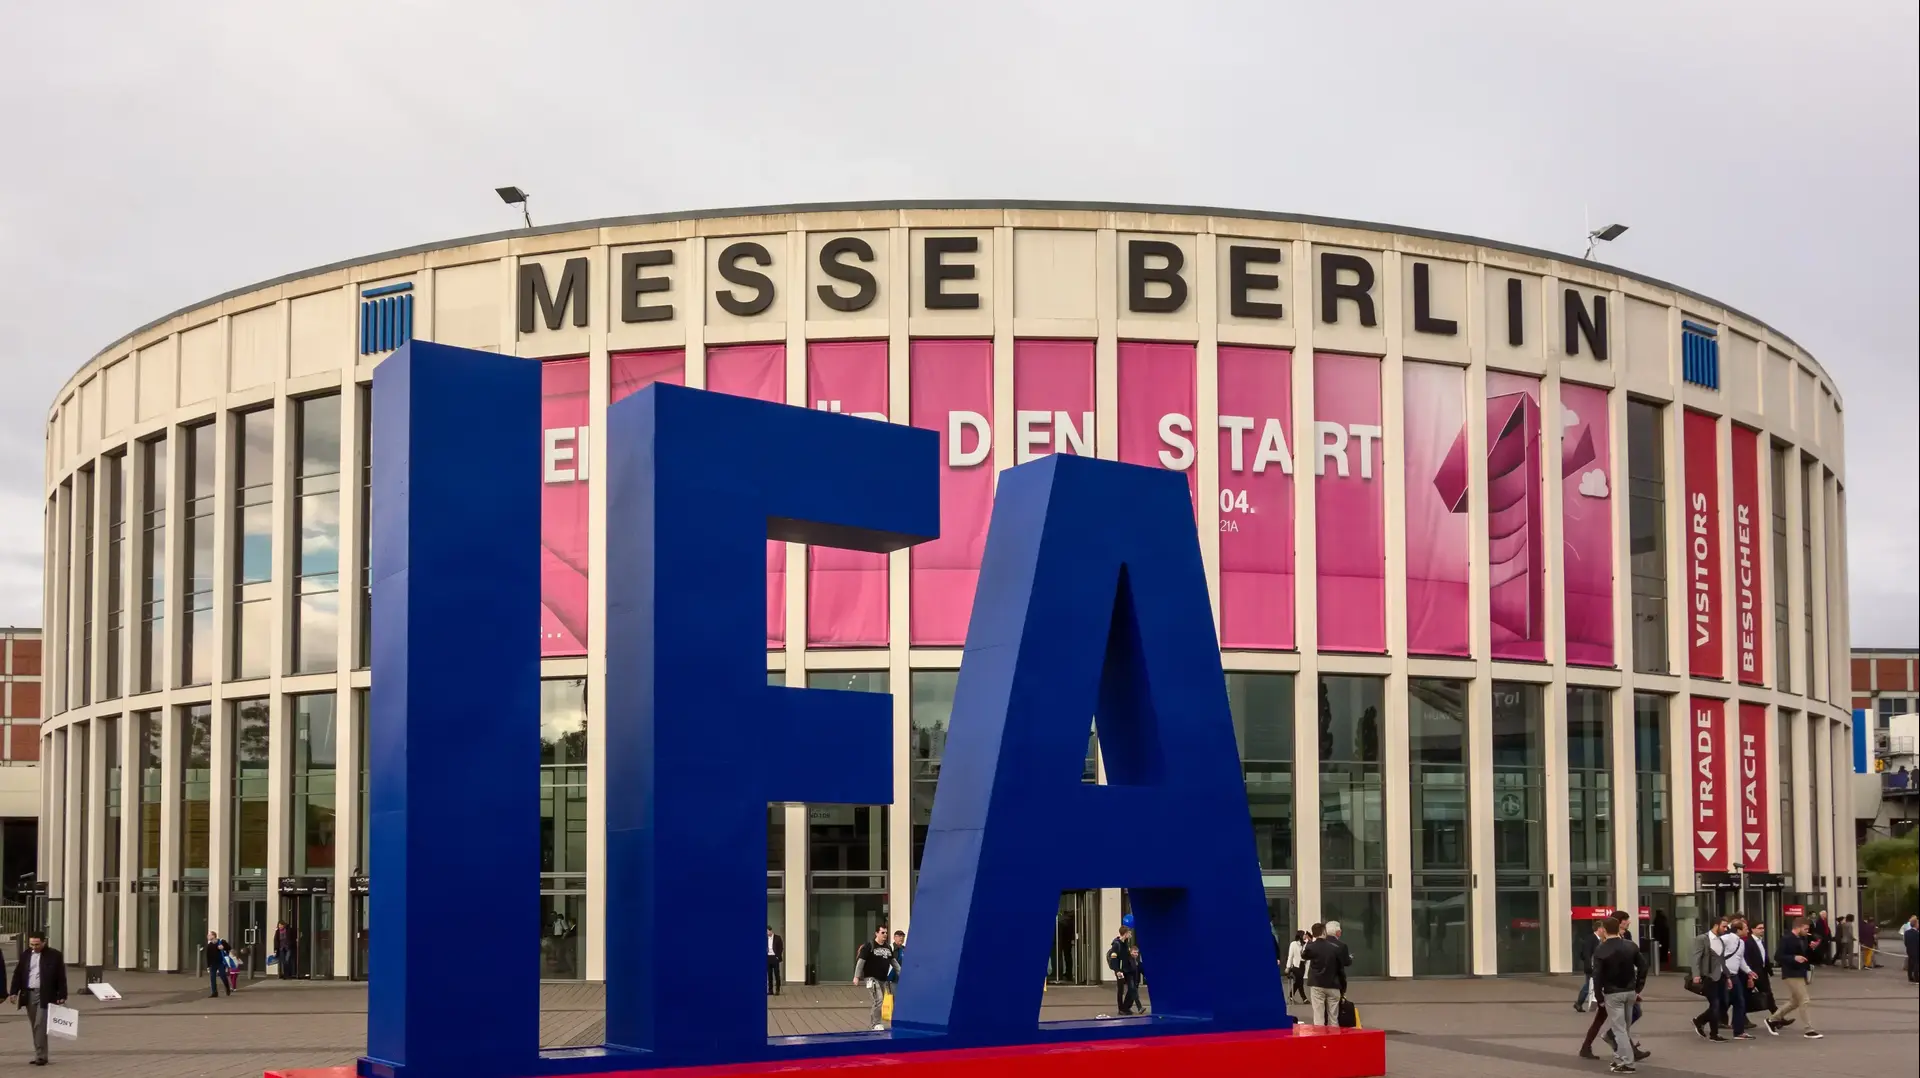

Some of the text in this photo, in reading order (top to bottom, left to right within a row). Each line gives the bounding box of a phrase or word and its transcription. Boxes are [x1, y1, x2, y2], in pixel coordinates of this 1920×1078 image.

[519, 237, 1608, 360] MESSE BERLIN
[949, 410, 1095, 467] DEN
[1158, 413, 1383, 479] START
[1219, 519, 1239, 533] 21A
[1691, 492, 1709, 648] VISITORS
[1738, 504, 1755, 673] BESUCHER
[366, 340, 1290, 1077] IFA
[1697, 708, 1713, 823] TRADE
[1743, 733, 1757, 825] FACH
[53, 1017, 74, 1027] SONY
